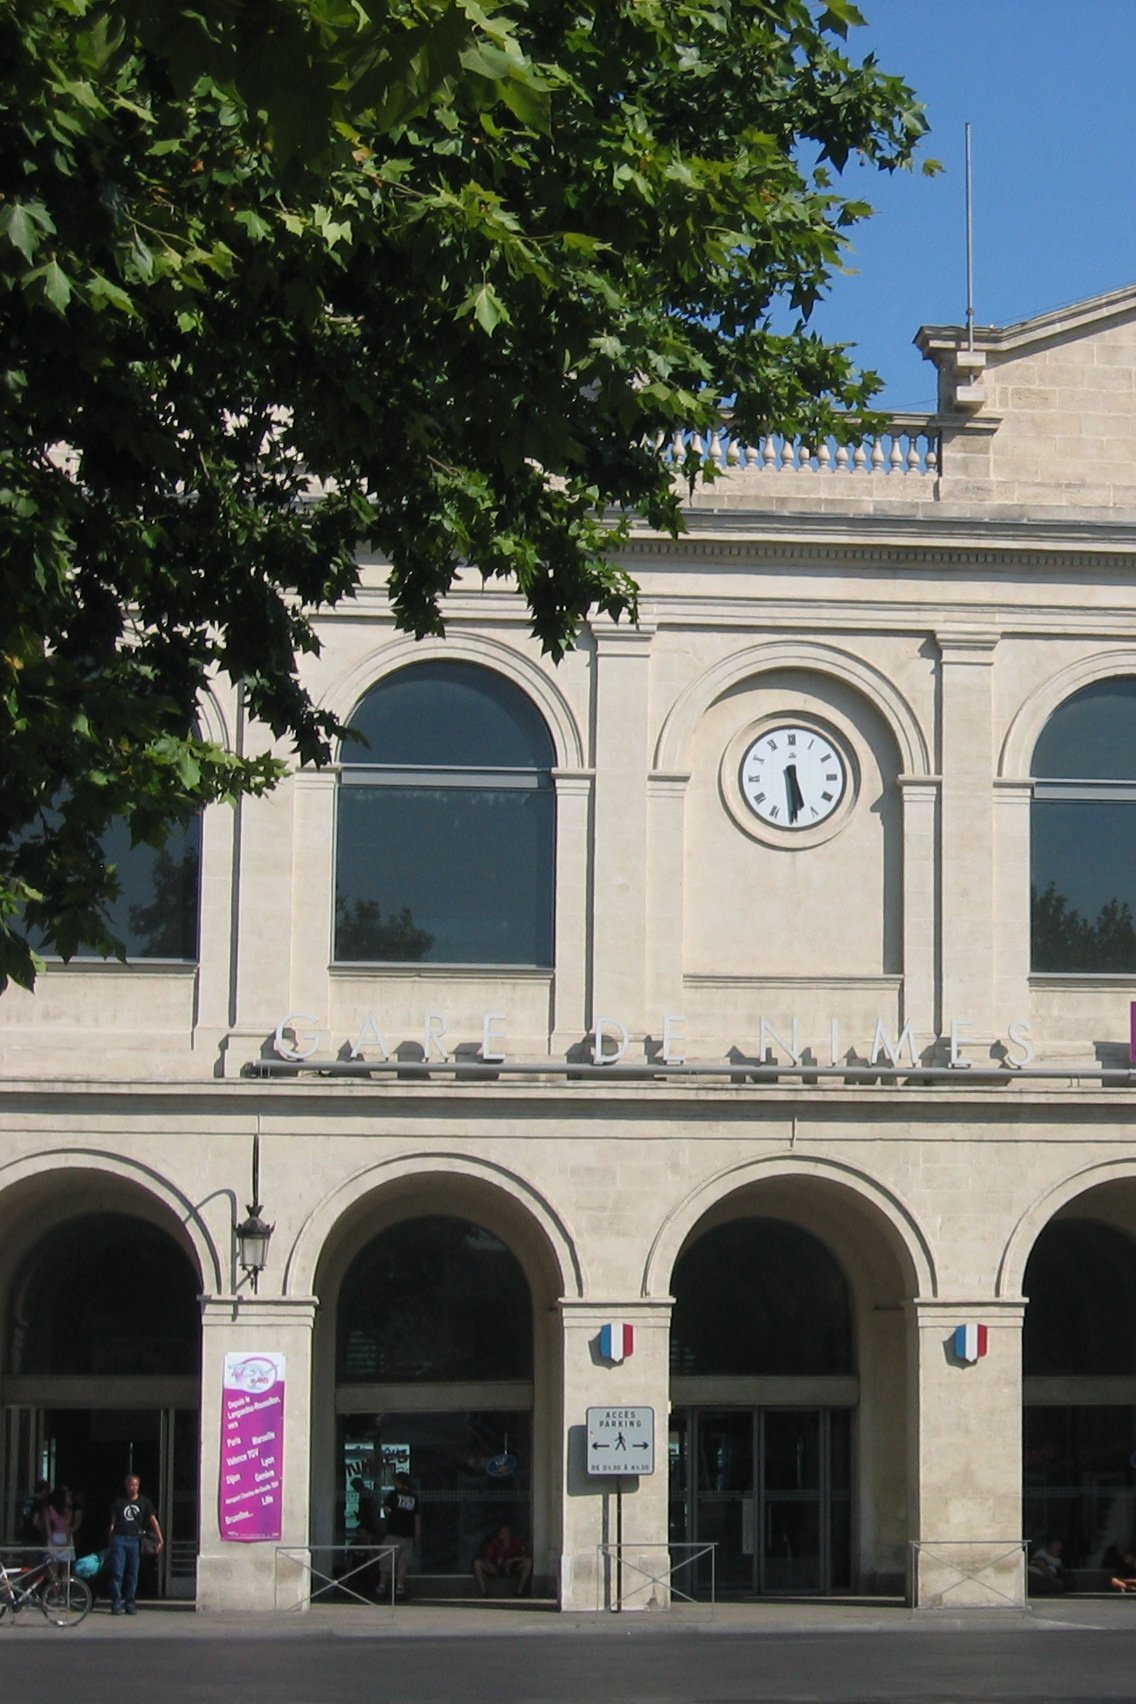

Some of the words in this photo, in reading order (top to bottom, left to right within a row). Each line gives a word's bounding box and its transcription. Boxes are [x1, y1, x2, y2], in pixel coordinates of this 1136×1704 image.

[275, 1013, 506, 1061] GARE
[595, 1016, 687, 1064] DE
[759, 1016, 1035, 1066] NIMES
[226, 1437, 241, 1447] Paris
[261, 1456, 275, 1467] Lyon
